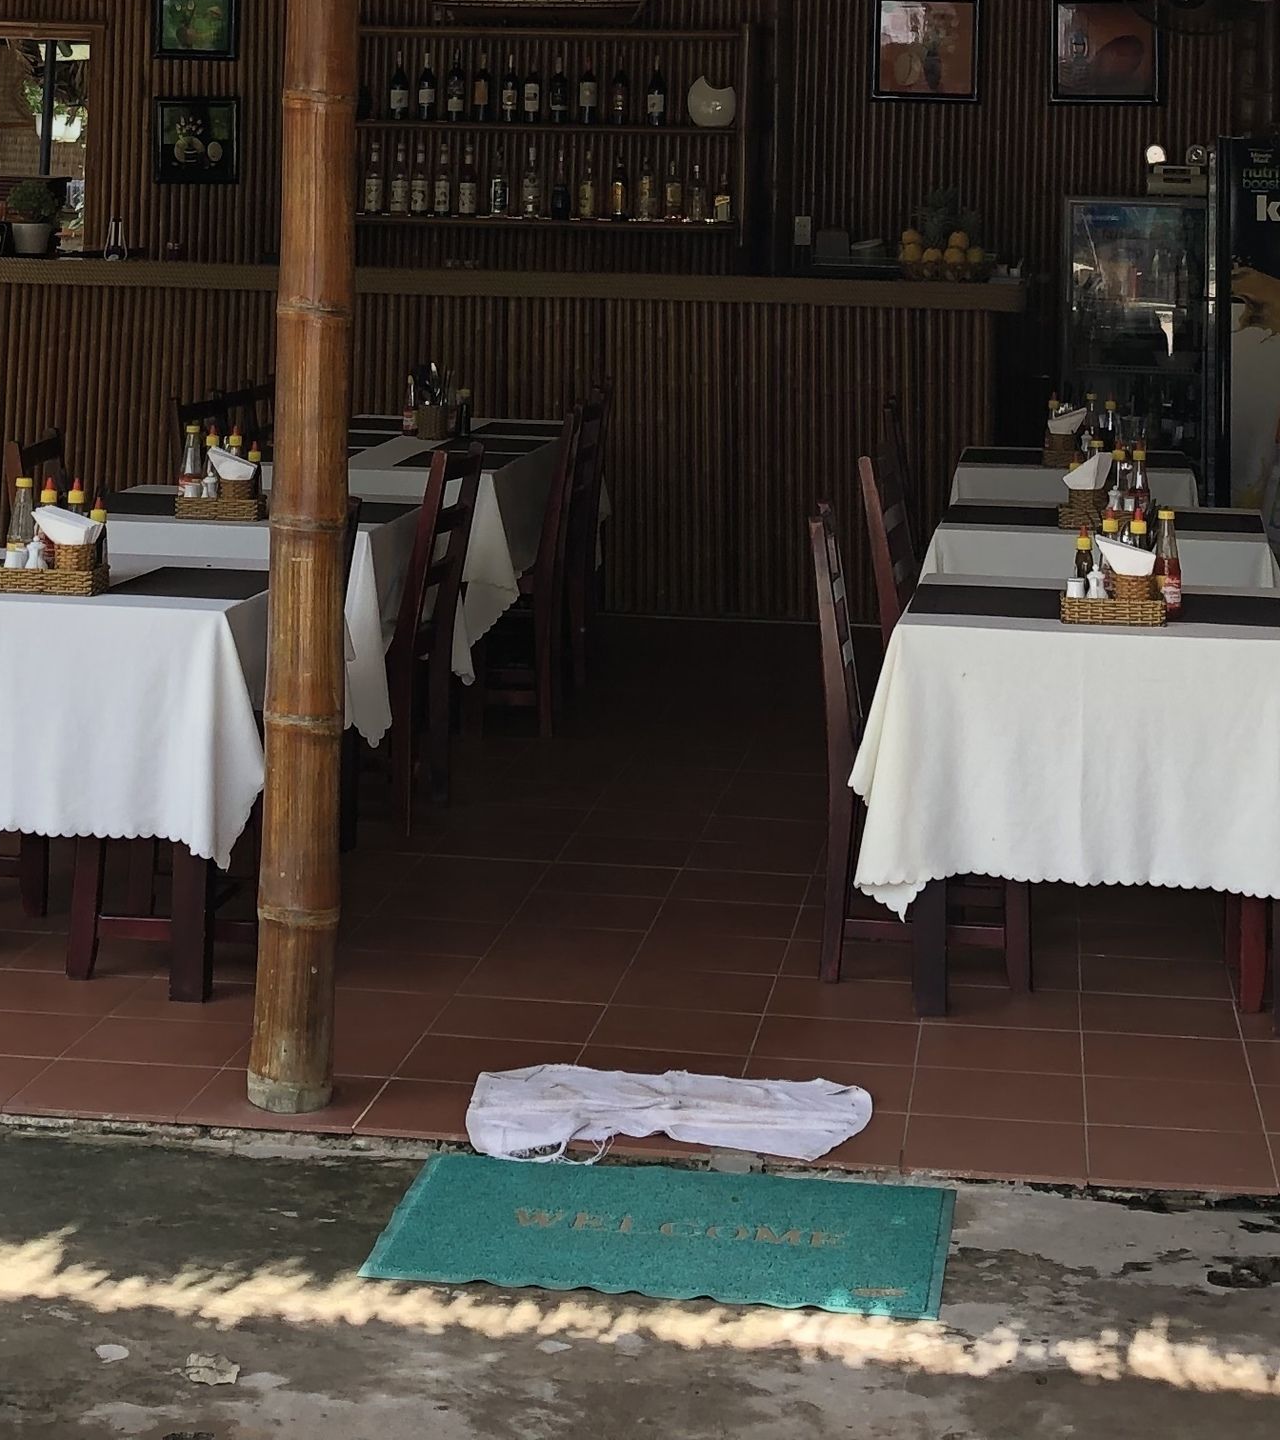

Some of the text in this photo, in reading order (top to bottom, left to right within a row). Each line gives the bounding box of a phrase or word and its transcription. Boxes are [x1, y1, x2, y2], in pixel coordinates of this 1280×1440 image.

[1243, 165, 1280, 177] nutri
[1243, 178, 1280, 189] boost
[516, 1208, 846, 1249] WELCOME
